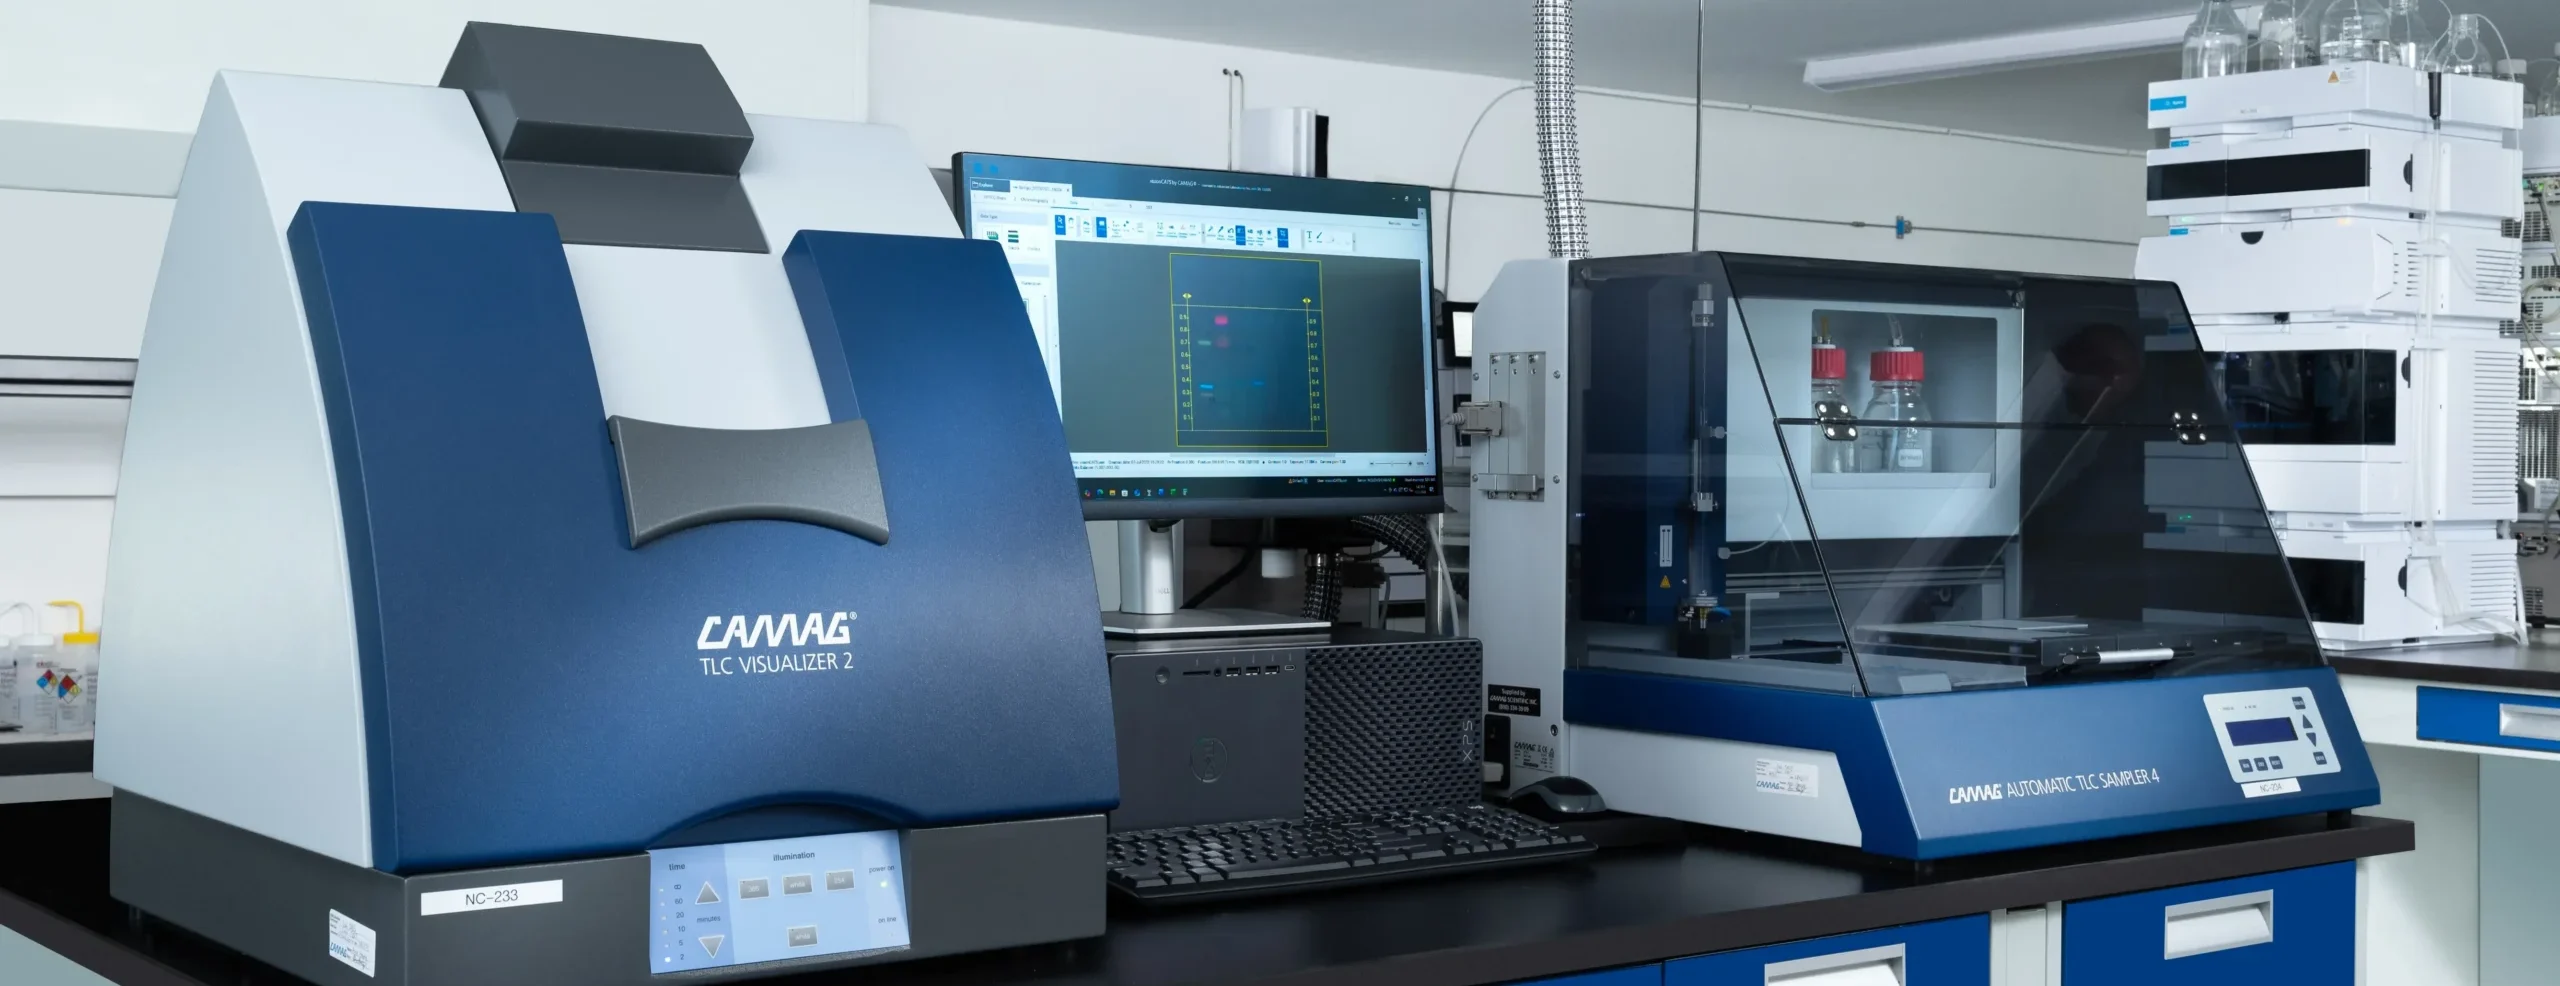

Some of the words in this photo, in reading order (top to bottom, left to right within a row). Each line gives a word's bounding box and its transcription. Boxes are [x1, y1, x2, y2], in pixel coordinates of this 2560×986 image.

[700, 657, 733, 675] TLC
[738, 653, 838, 674] VISUALIZER
[843, 652, 854, 669] 2
[1462, 720, 1472, 761] XPS
[1756, 780, 1780, 789] CAMAG
[1949, 783, 2003, 804] CAMAG
[2007, 776, 2076, 798] AUTOMATIC
[2076, 773, 2099, 790] TLC
[2099, 769, 2151, 789] SAMPLER
[2151, 768, 2160, 782] 4
[773, 851, 816, 862] illumination
[669, 863, 686, 871] time
[868, 866, 886, 874] power
[465, 889, 519, 906] NC-233
[696, 915, 721, 923] minutes
[886, 915, 897, 923] line
